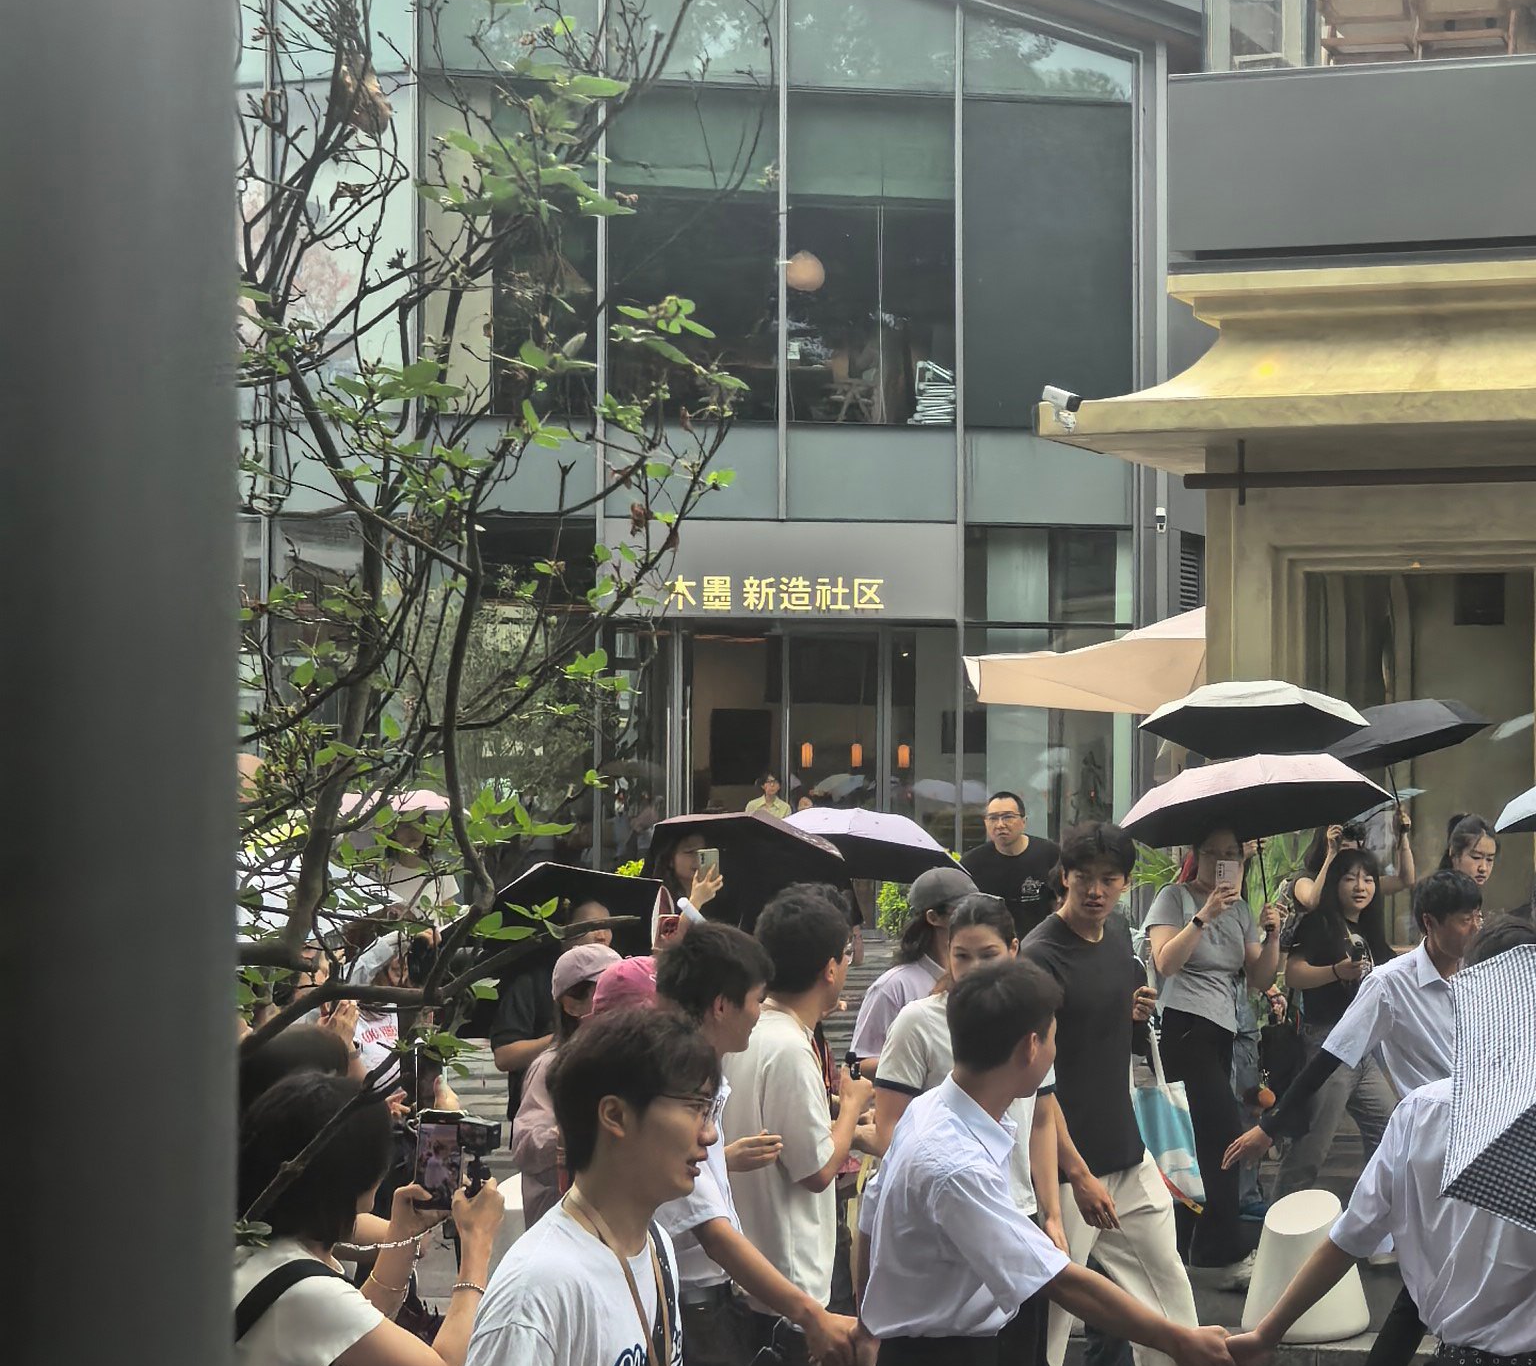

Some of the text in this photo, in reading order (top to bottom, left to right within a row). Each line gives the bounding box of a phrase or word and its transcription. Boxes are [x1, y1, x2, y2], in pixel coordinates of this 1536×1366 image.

[664, 575, 884, 611] 木墨 新造社区
